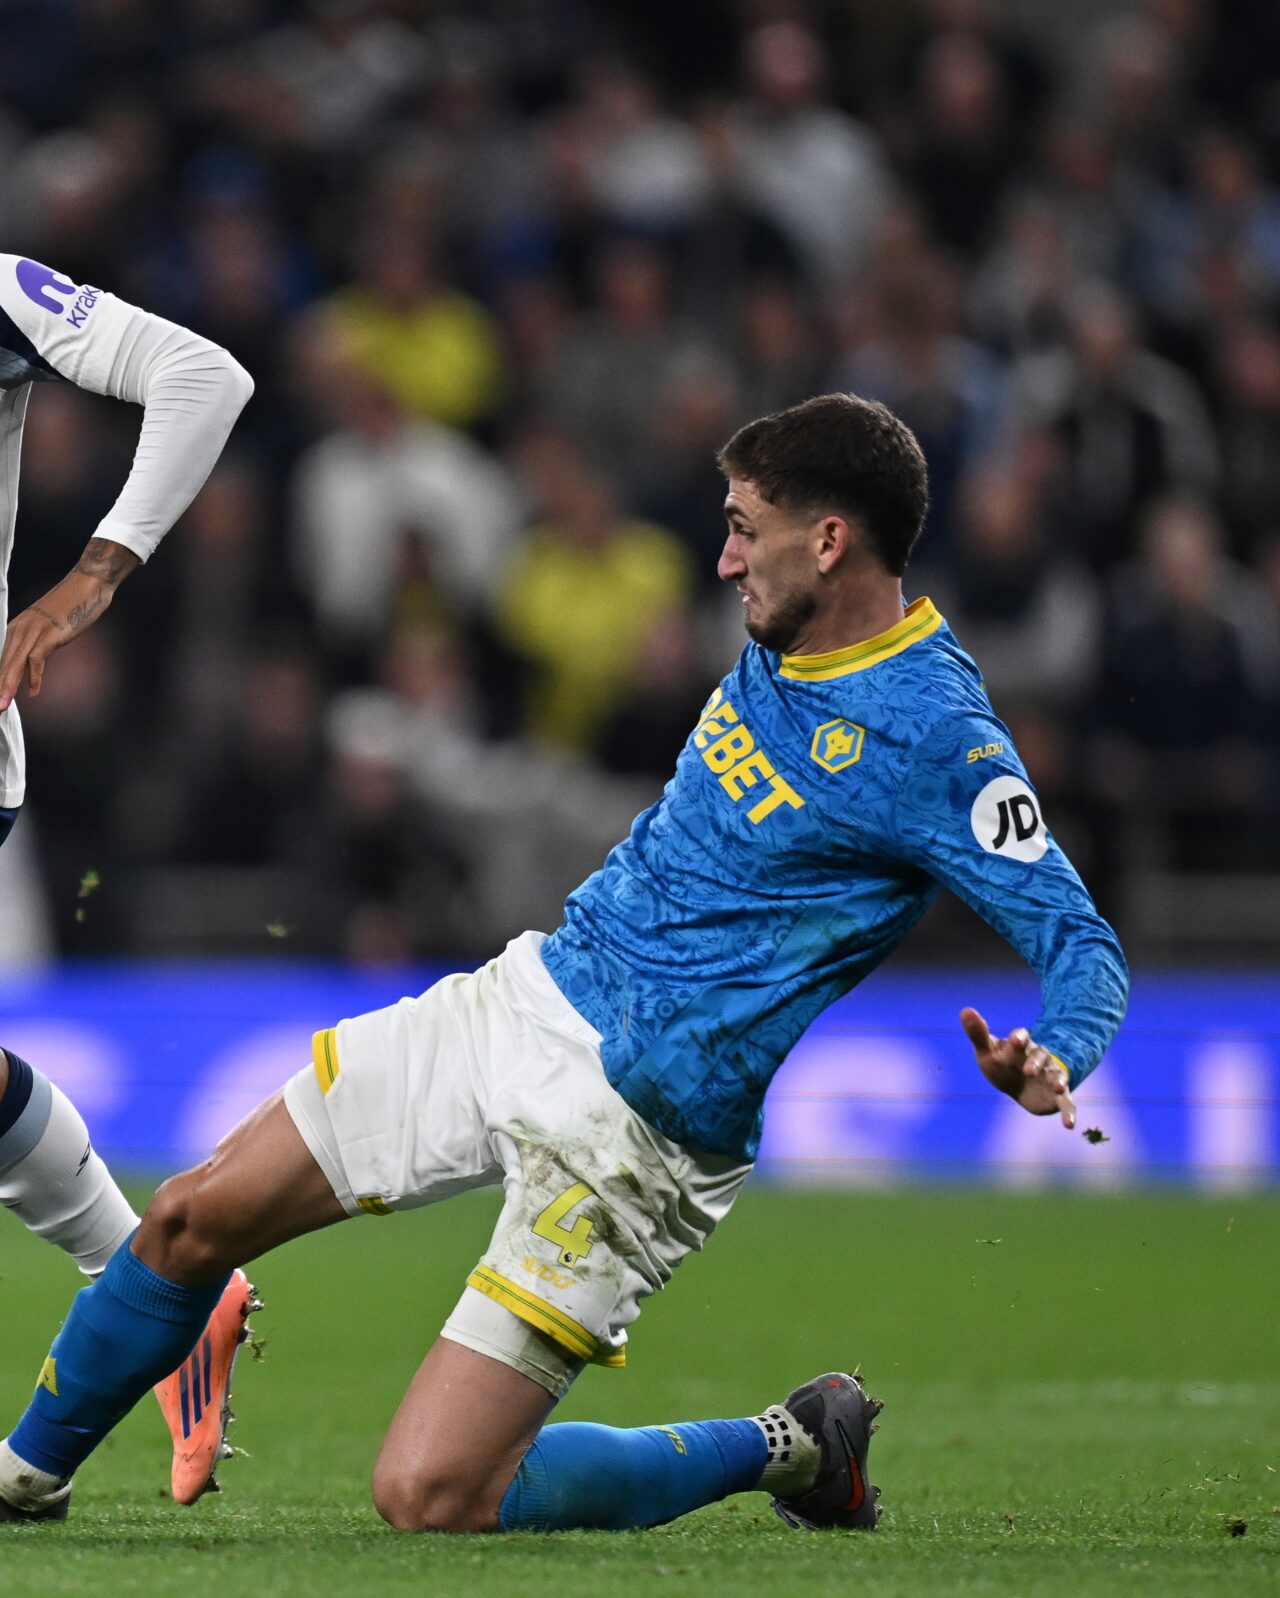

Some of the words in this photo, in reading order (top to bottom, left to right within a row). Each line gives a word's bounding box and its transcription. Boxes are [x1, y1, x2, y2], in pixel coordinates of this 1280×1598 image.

[965, 742, 1005, 764] SUDU
[991, 793, 1039, 850] JD
[530, 1180, 595, 1270] 4
